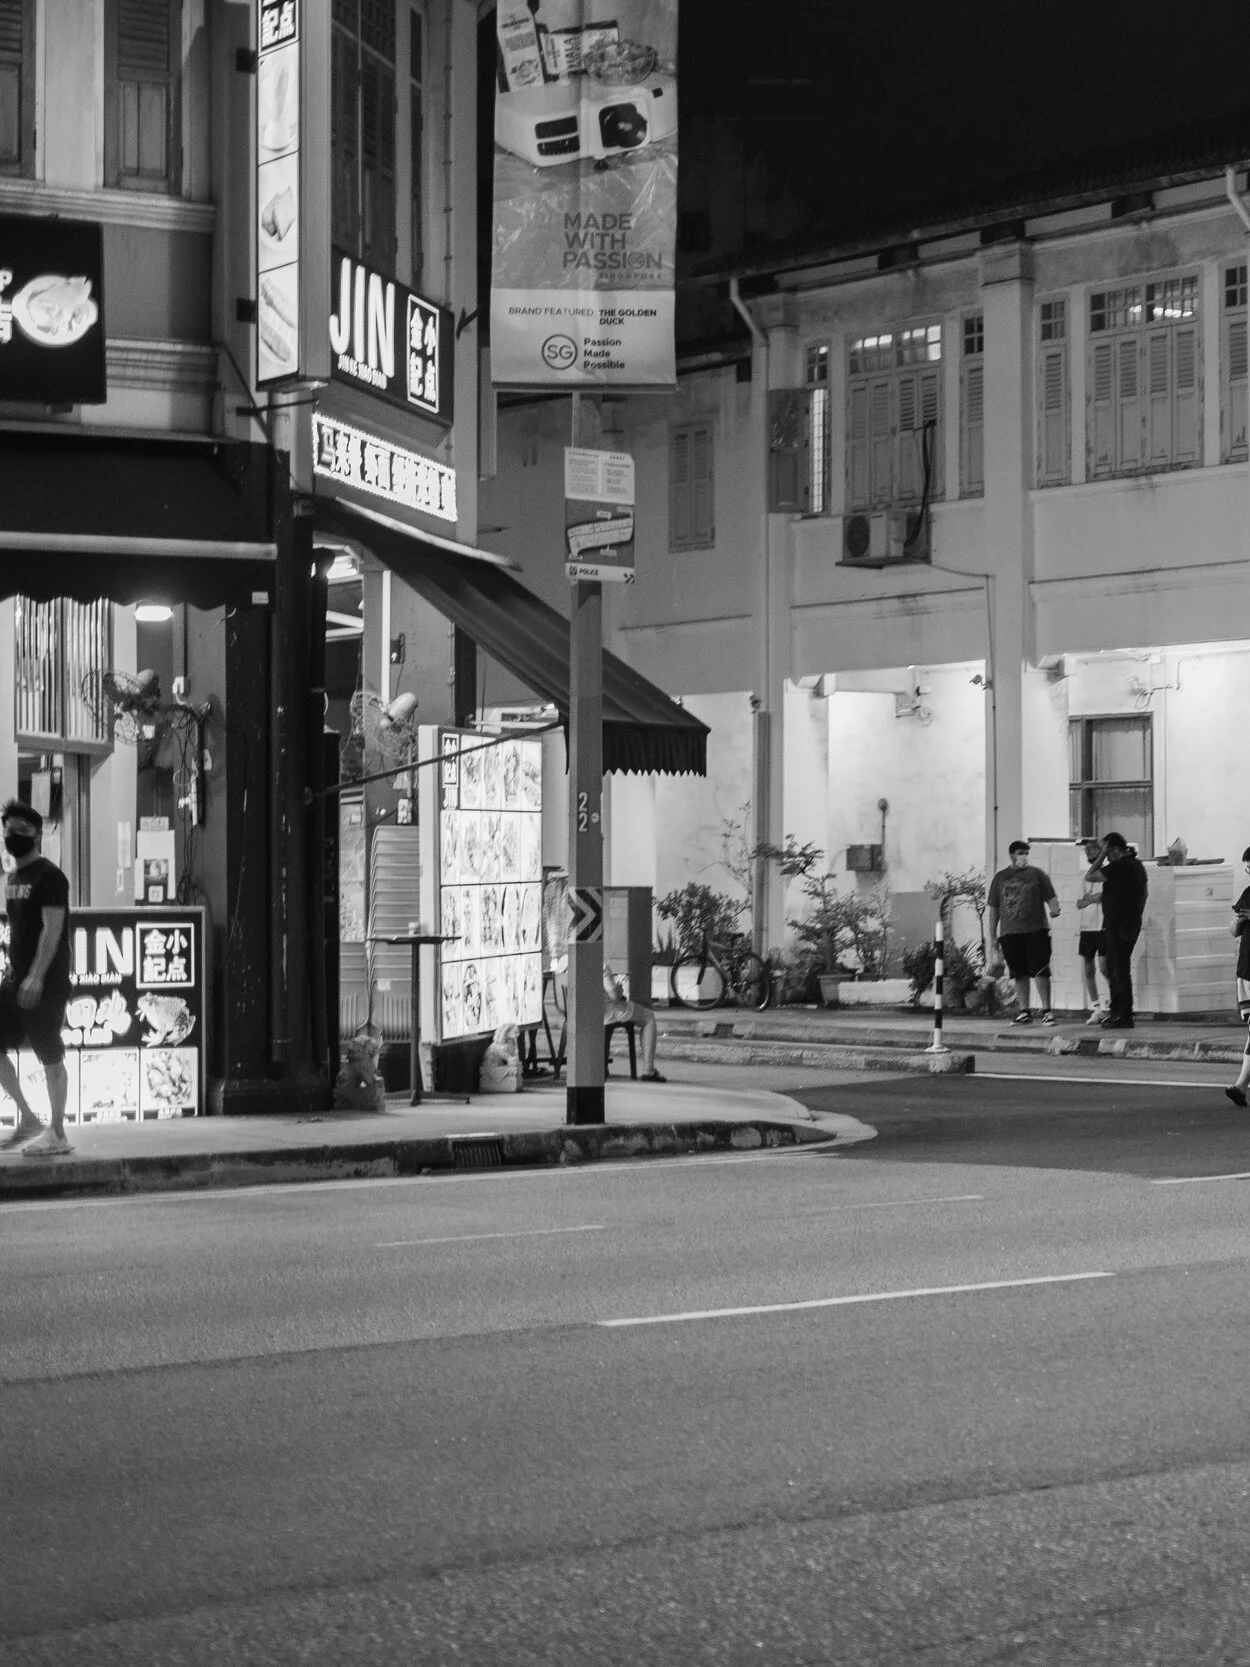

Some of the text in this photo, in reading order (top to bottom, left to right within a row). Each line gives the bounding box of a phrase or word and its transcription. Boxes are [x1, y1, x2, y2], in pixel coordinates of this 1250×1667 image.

[564, 212, 633, 231] MADE
[564, 231, 626, 250] WITH
[562, 251, 663, 270] PASSION
[329, 257, 395, 378] JIN
[508, 306, 542, 316] BRAND
[599, 308, 616, 317] THE
[618, 308, 657, 317] GOLDEN
[599, 317, 625, 326] DUCK
[583, 337, 622, 347] Passion
[546, 344, 574, 360] SG
[583, 349, 611, 358] Made
[583, 360, 626, 370] Possible
[75, 926, 134, 977] IN
